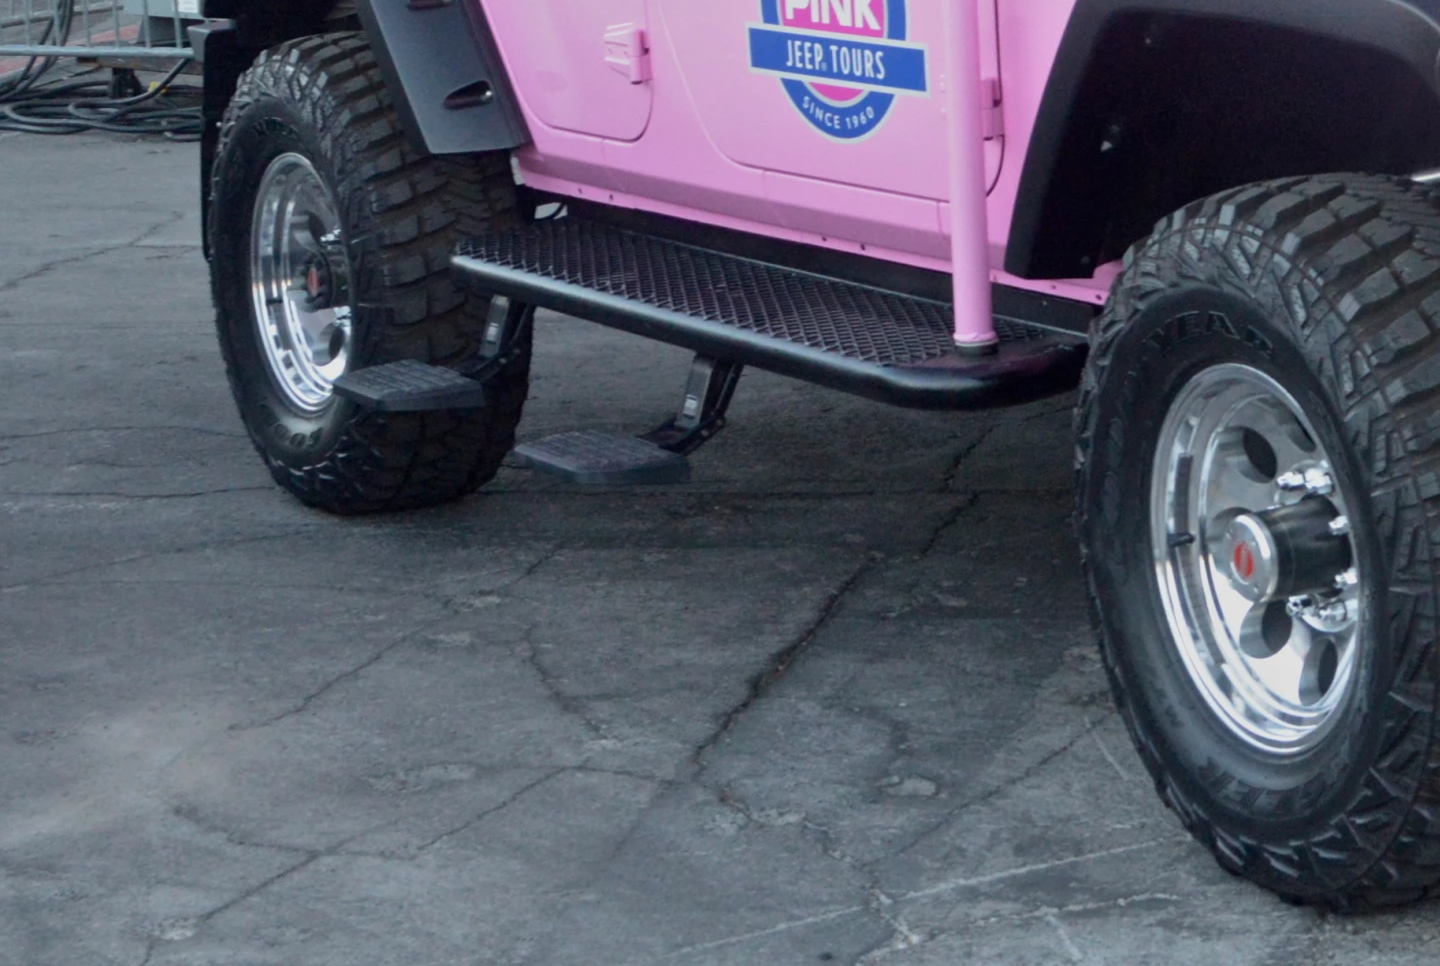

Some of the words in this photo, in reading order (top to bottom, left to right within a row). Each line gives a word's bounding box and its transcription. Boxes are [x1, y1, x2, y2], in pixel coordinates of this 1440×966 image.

[829, 45, 886, 80] TOURS
[802, 95, 841, 129] SINCE
[845, 106, 875, 129] 1960
